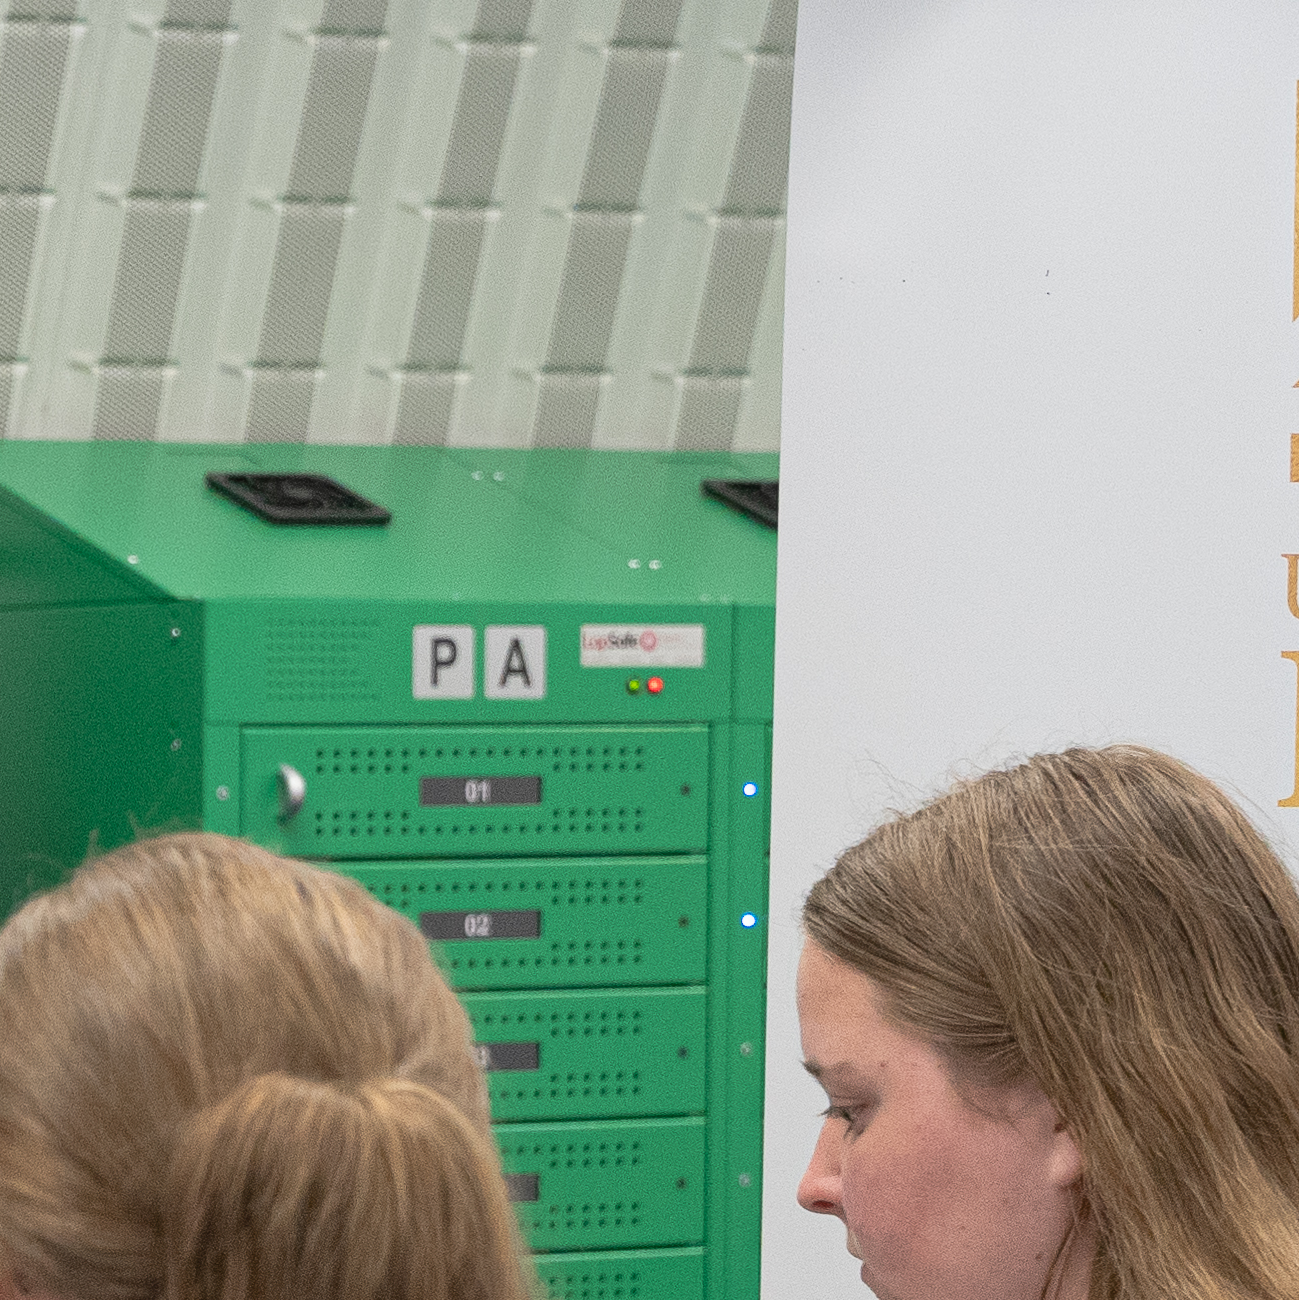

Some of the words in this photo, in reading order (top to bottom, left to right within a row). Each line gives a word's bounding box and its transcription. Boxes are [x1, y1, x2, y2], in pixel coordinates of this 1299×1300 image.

[431, 637, 459, 686] P
[499, 638, 531, 688] A
[464, 780, 490, 803] 01
[464, 913, 491, 937] 02
